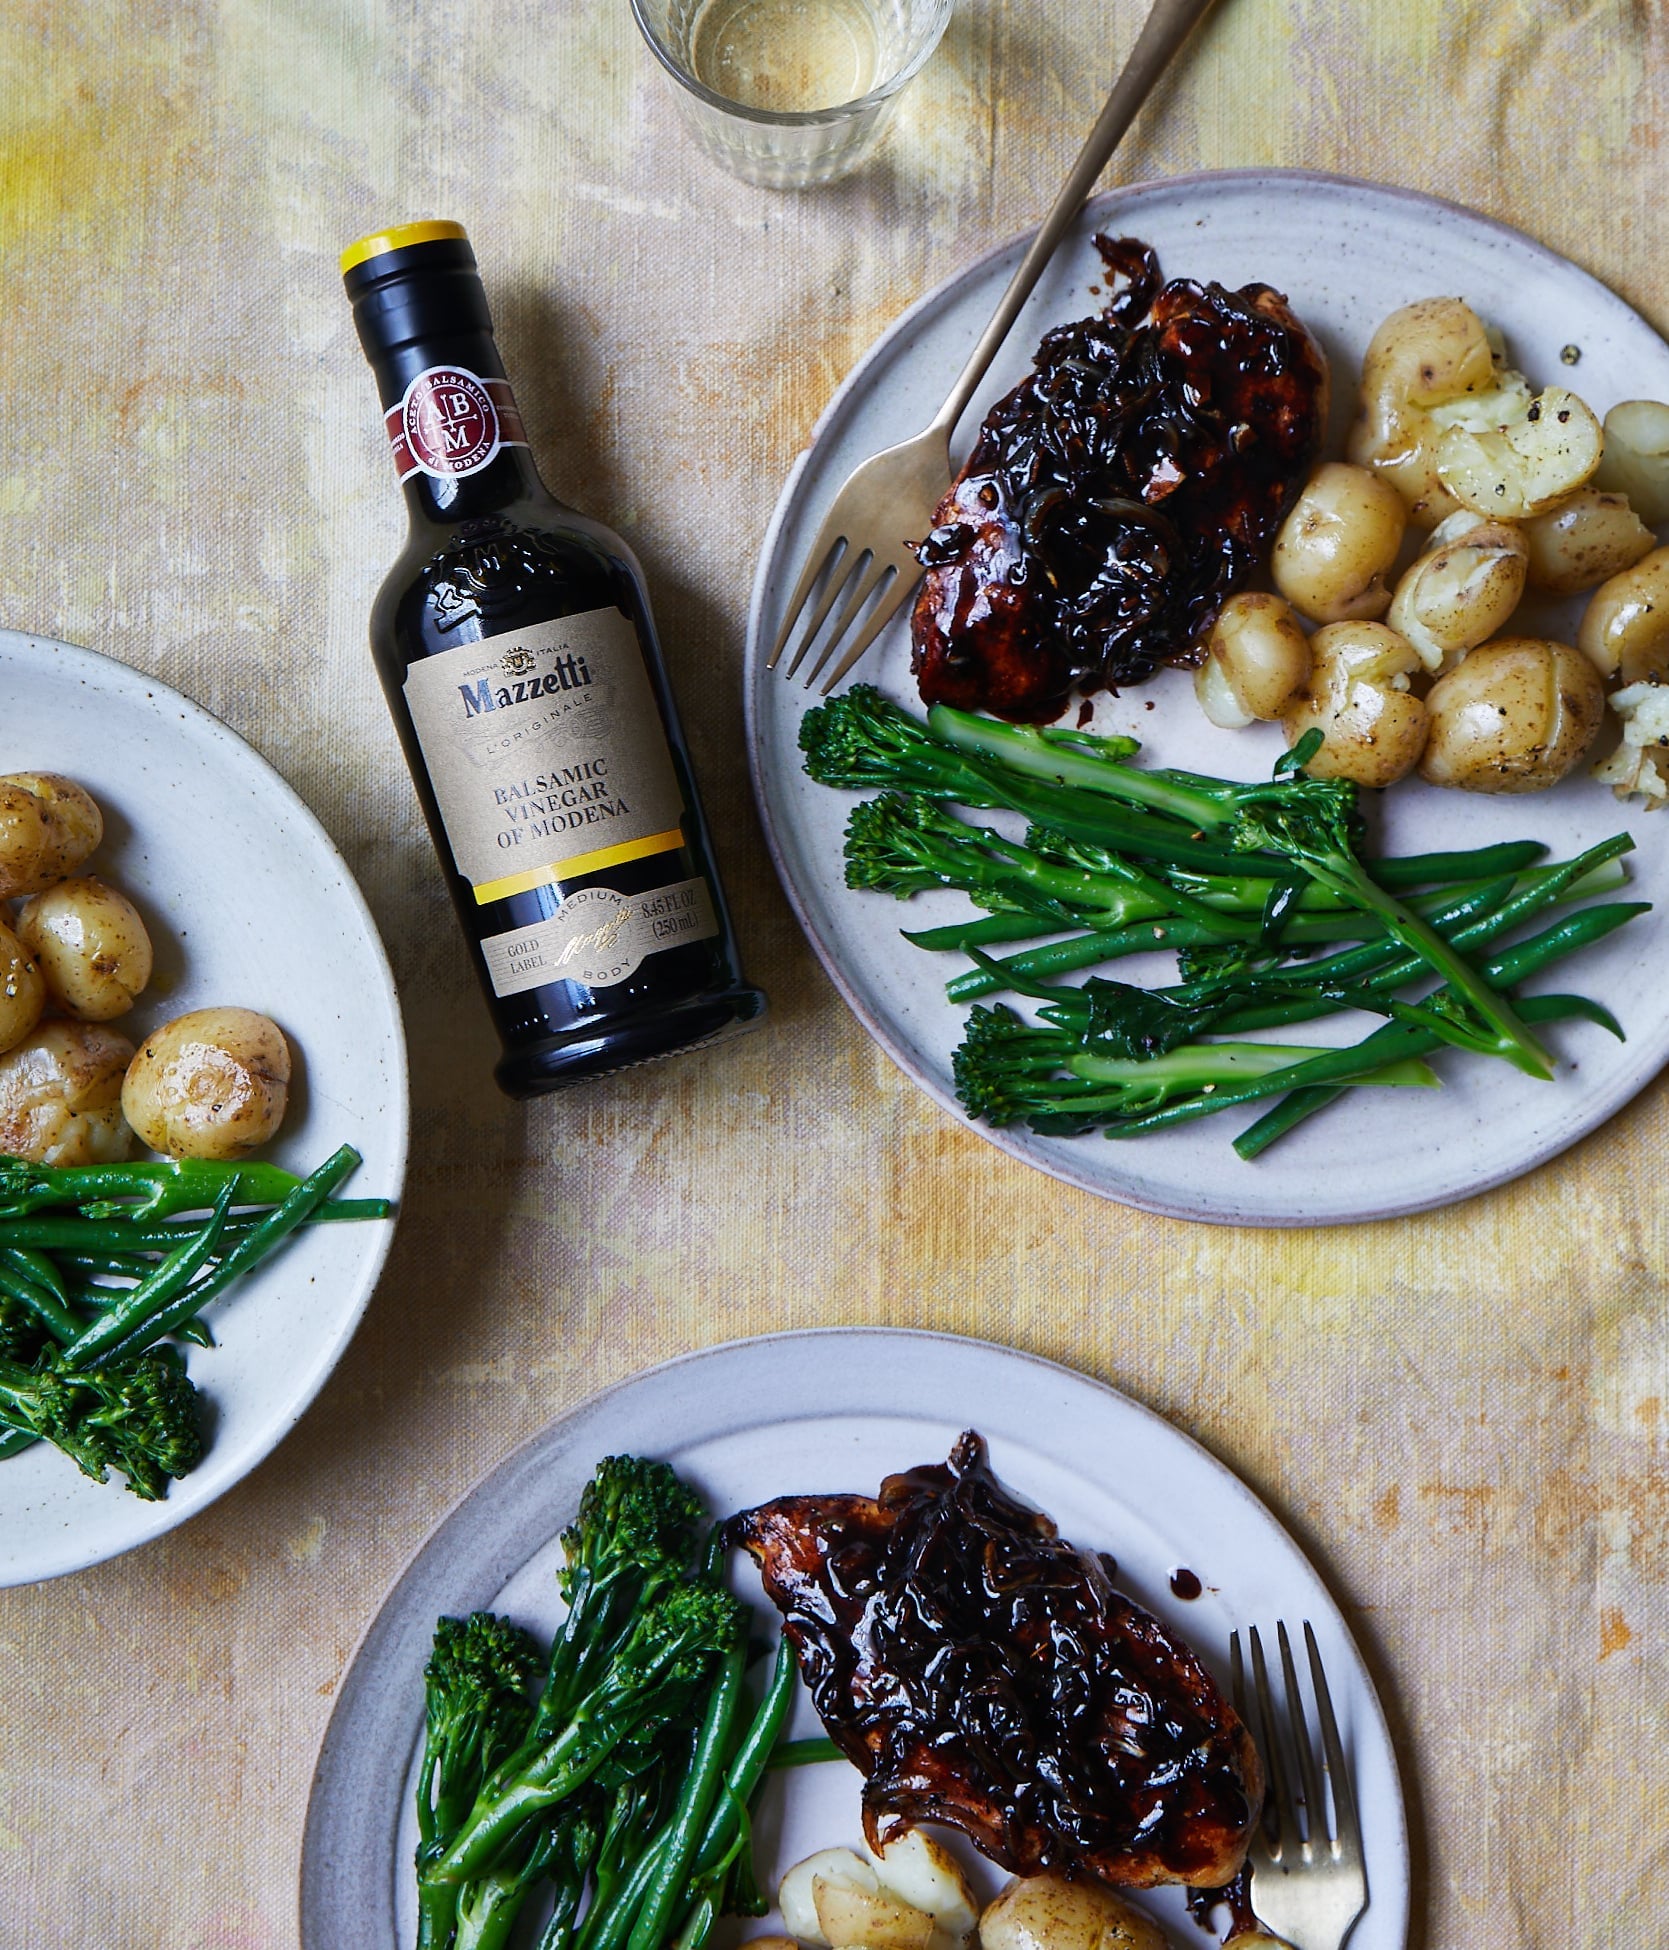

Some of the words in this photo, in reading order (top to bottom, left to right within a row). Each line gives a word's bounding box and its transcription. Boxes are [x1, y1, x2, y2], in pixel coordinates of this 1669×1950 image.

[408, 391, 423, 434] ACETO
[424, 375, 490, 413] BALSAMICO
[536, 643, 569, 656] ITALIA
[458, 653, 592, 719] Mazzetti
[494, 758, 608, 805] BALSAMIC
[505, 781, 609, 822] VINEGAR
[497, 828, 523, 849] OF
[529, 798, 630, 840] MODENA
[558, 891, 622, 922] MEDIUM
[641, 899, 666, 918] 8.45
[665, 895, 682, 911] FL
[653, 919, 678, 940] (250
[507, 939, 540, 958] GOLD
[510, 955, 548, 974] LABEL
[582, 957, 631, 980] BODY
